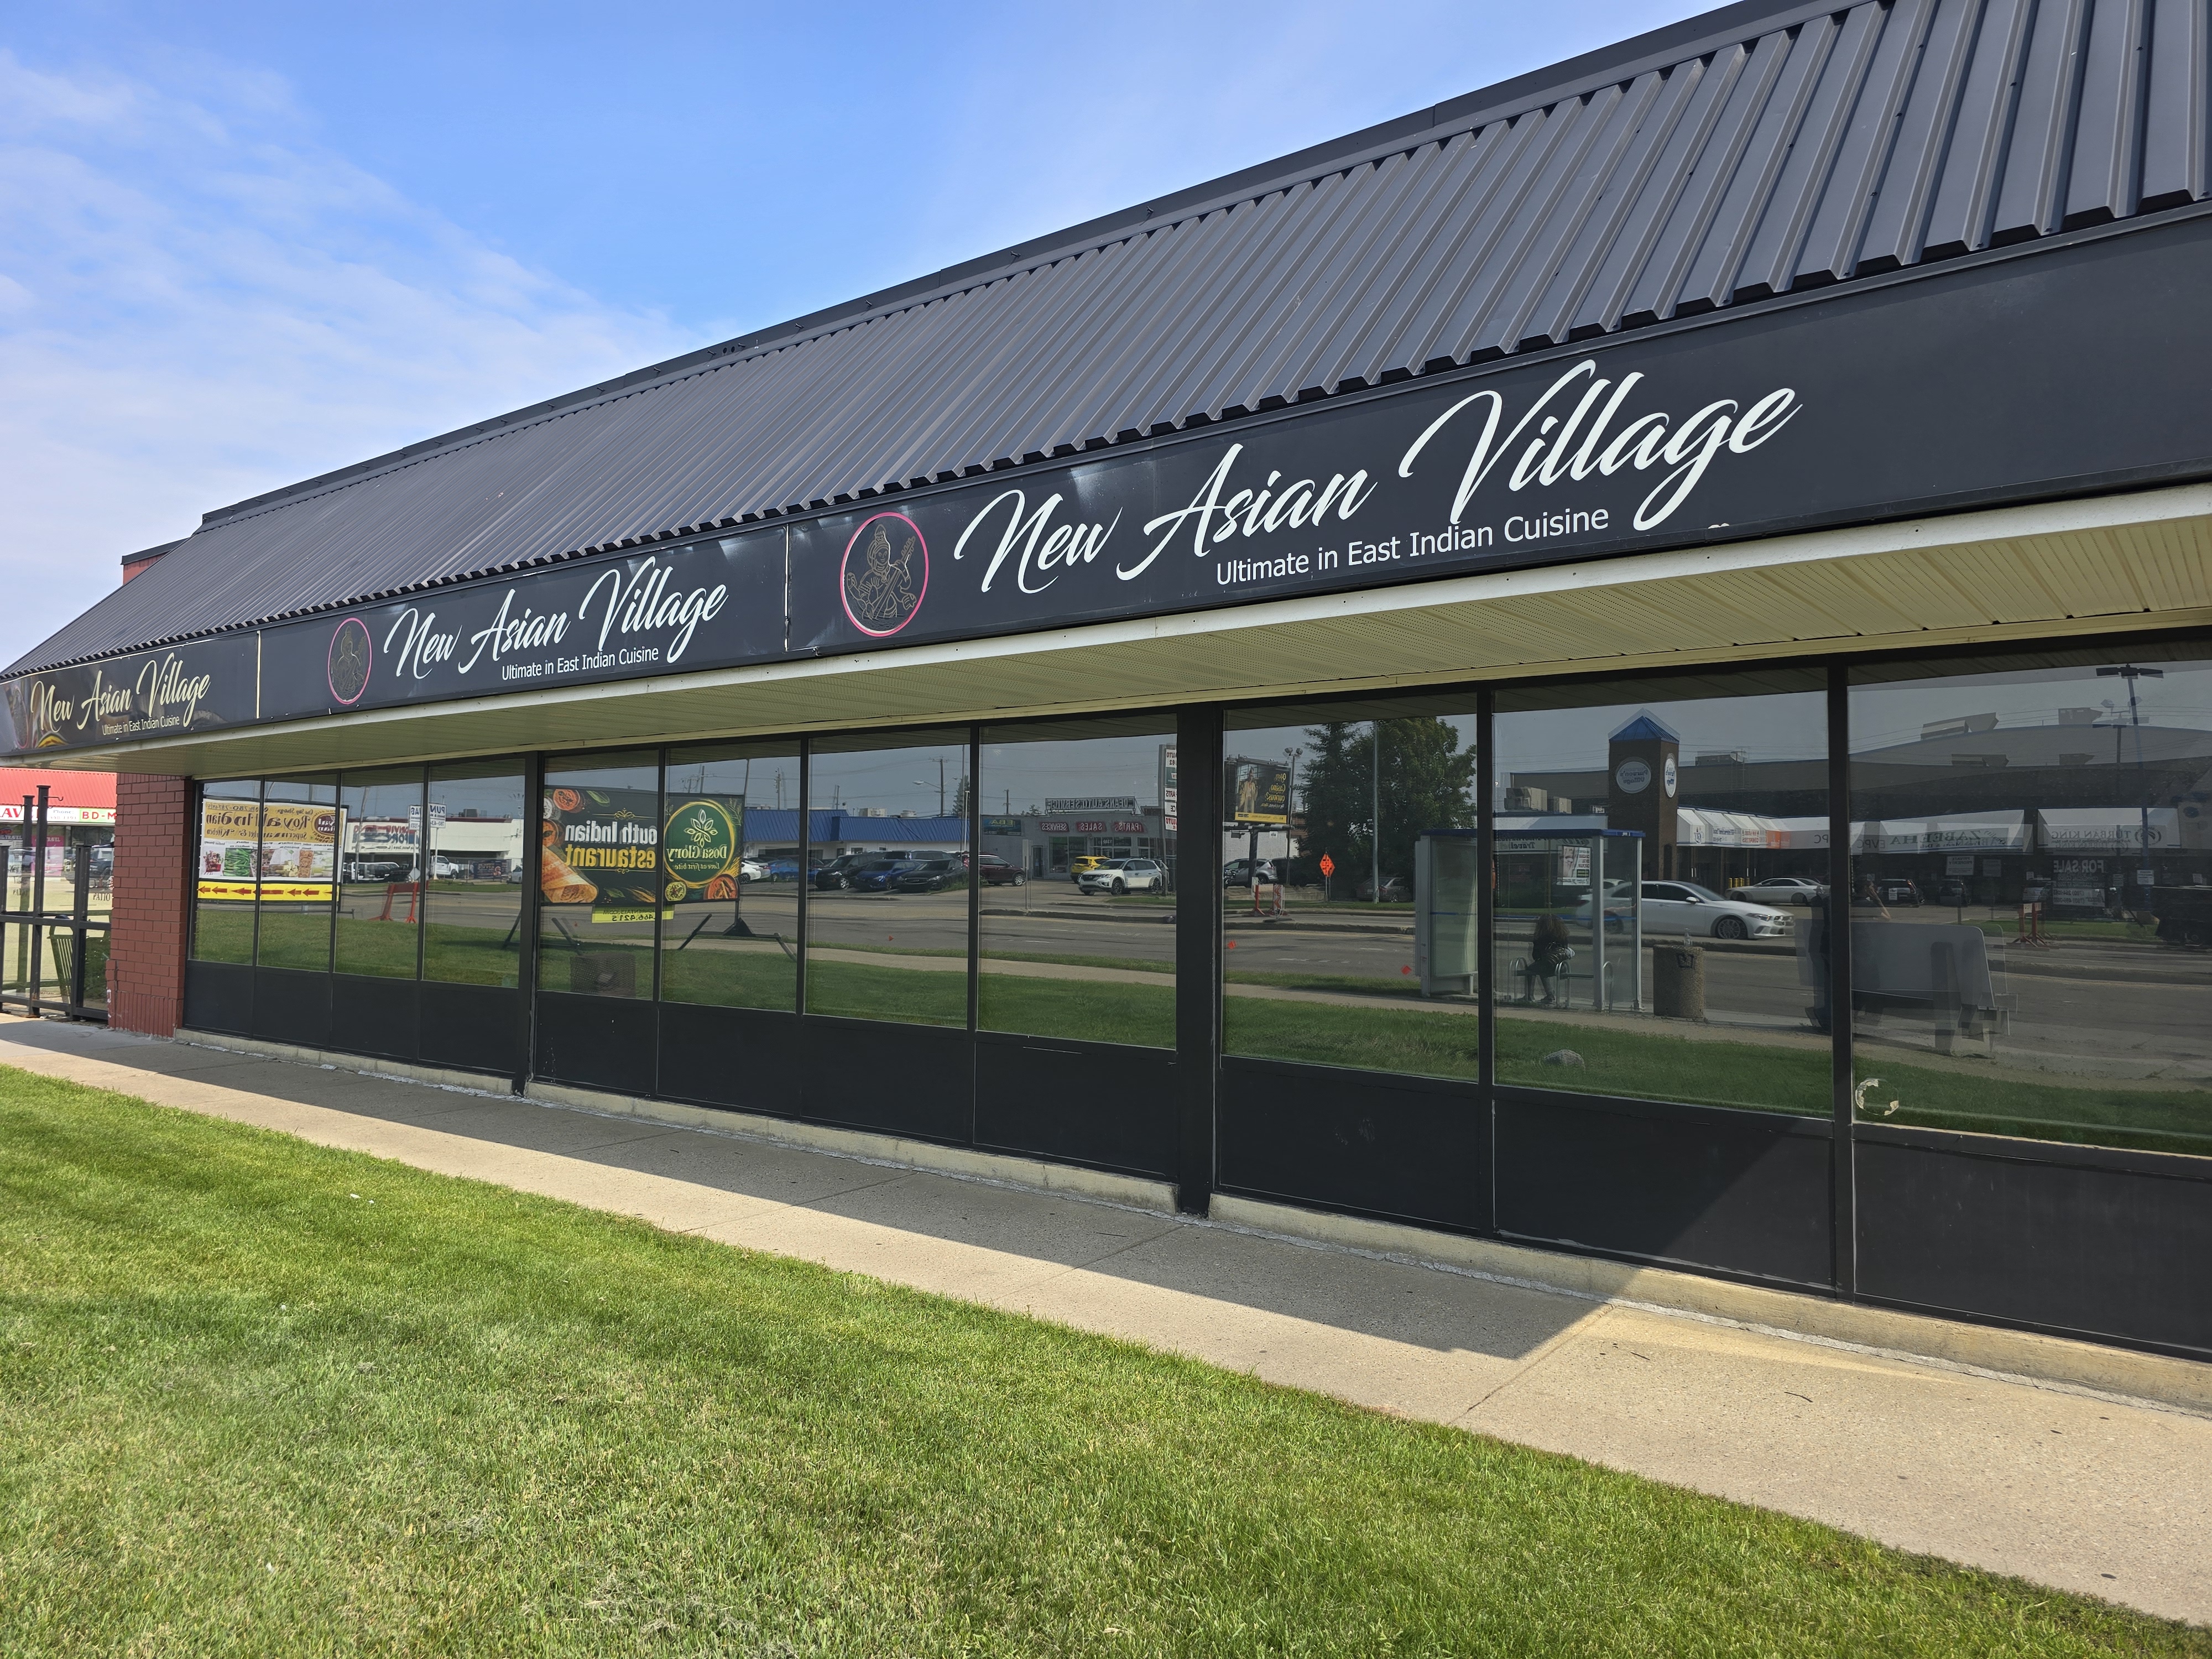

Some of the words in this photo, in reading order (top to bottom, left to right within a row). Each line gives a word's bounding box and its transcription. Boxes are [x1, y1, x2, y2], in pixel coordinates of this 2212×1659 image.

[954, 490, 1123, 594] New
[1117, 443, 1378, 581] Asian
[1399, 359, 1803, 531] Village
[1218, 552, 1309, 585] Ultimate
[1318, 547, 1338, 570] in
[1348, 536, 1401, 566] East
[1410, 525, 1493, 557] Indian
[1504, 508, 1609, 542] Cuisine
[383, 608, 462, 680] New
[458, 588, 571, 674] Asian
[578, 556, 729, 664] Village
[30, 680, 75, 733] New
[76, 670, 134, 730] Asian
[136, 652, 211, 727] Village
[502, 661, 542, 681] Ultimate
[545, 659, 554, 675] in
[557, 656, 580, 674] East
[582, 651, 615, 670] Indian
[619, 646, 659, 665] Cuisine
[102, 723, 123, 735] Ultimate
[123, 722, 129, 732] in
[129, 720, 141, 732] East
[141, 717, 160, 730] Indian
[160, 714, 180, 728] Cuisine
[93, 893, 111, 901] PATIO
